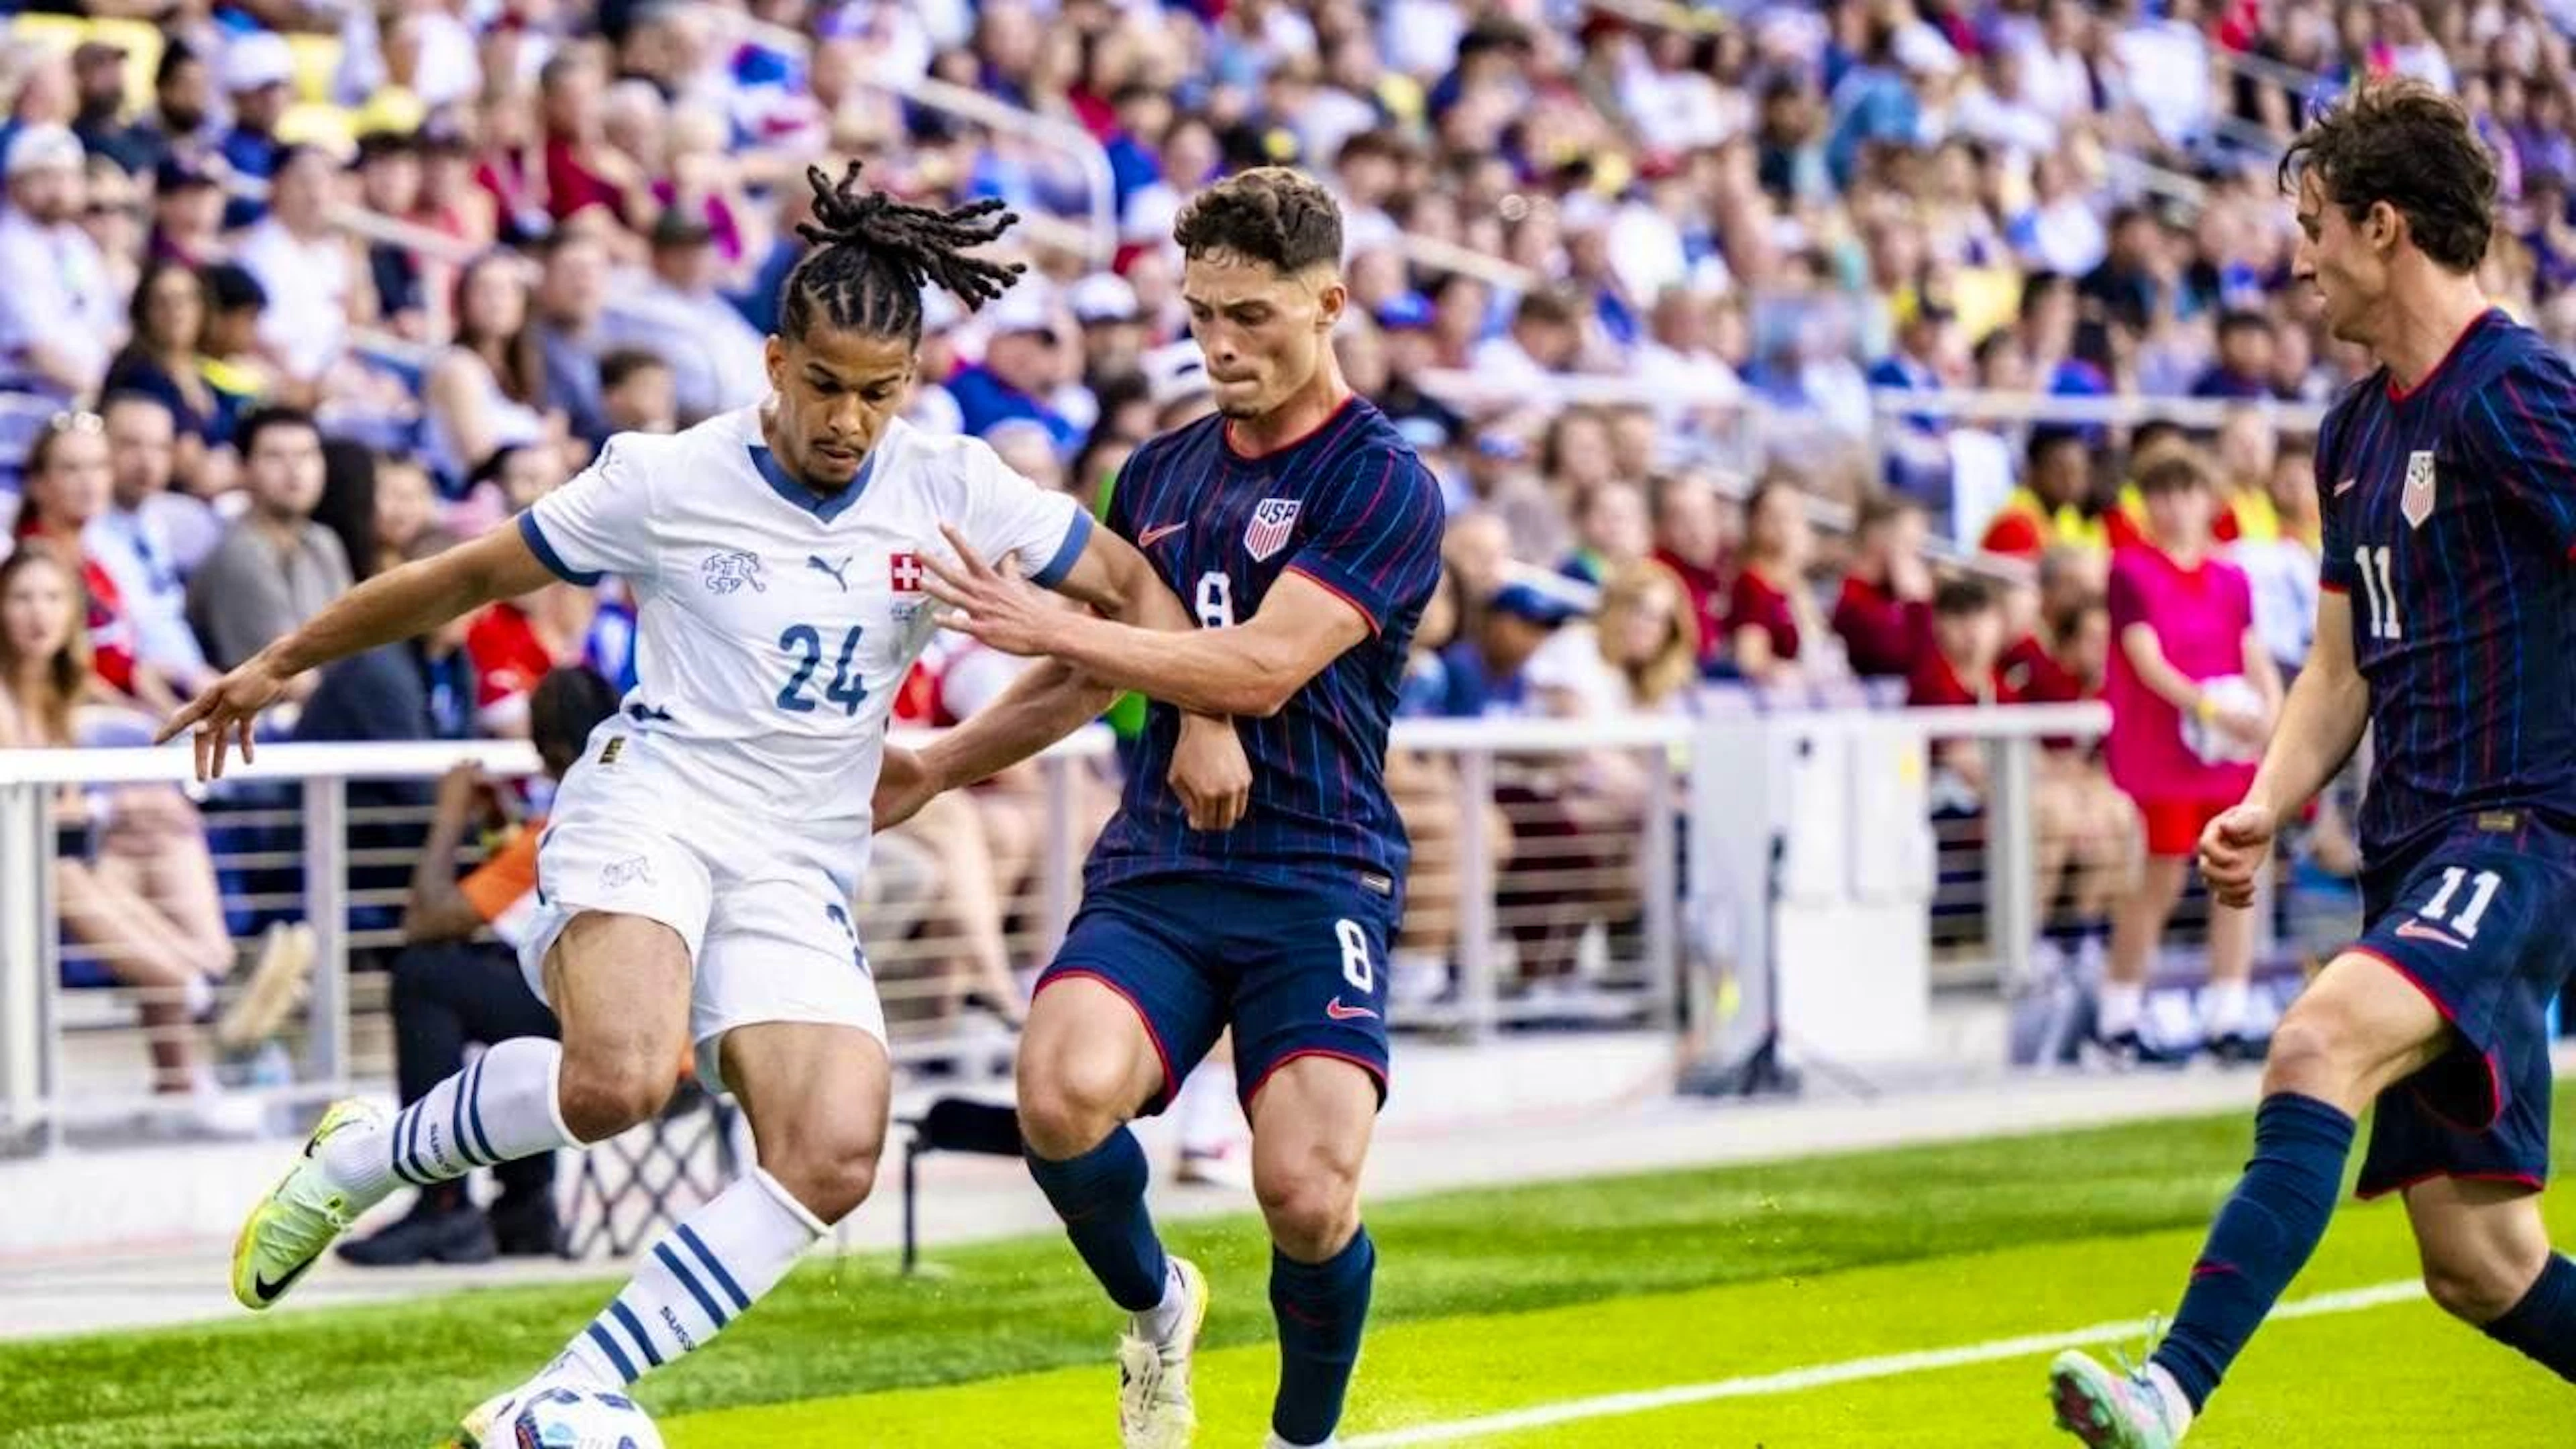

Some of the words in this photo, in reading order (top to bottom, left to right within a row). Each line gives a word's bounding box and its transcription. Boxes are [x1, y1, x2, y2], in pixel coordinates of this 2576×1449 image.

[1259, 500, 1297, 526] USA
[1195, 570, 1235, 629] 8
[2354, 544, 2403, 640] 11
[777, 624, 869, 717] 24
[2418, 865, 2502, 940] 11
[1335, 918, 1374, 995] 8
